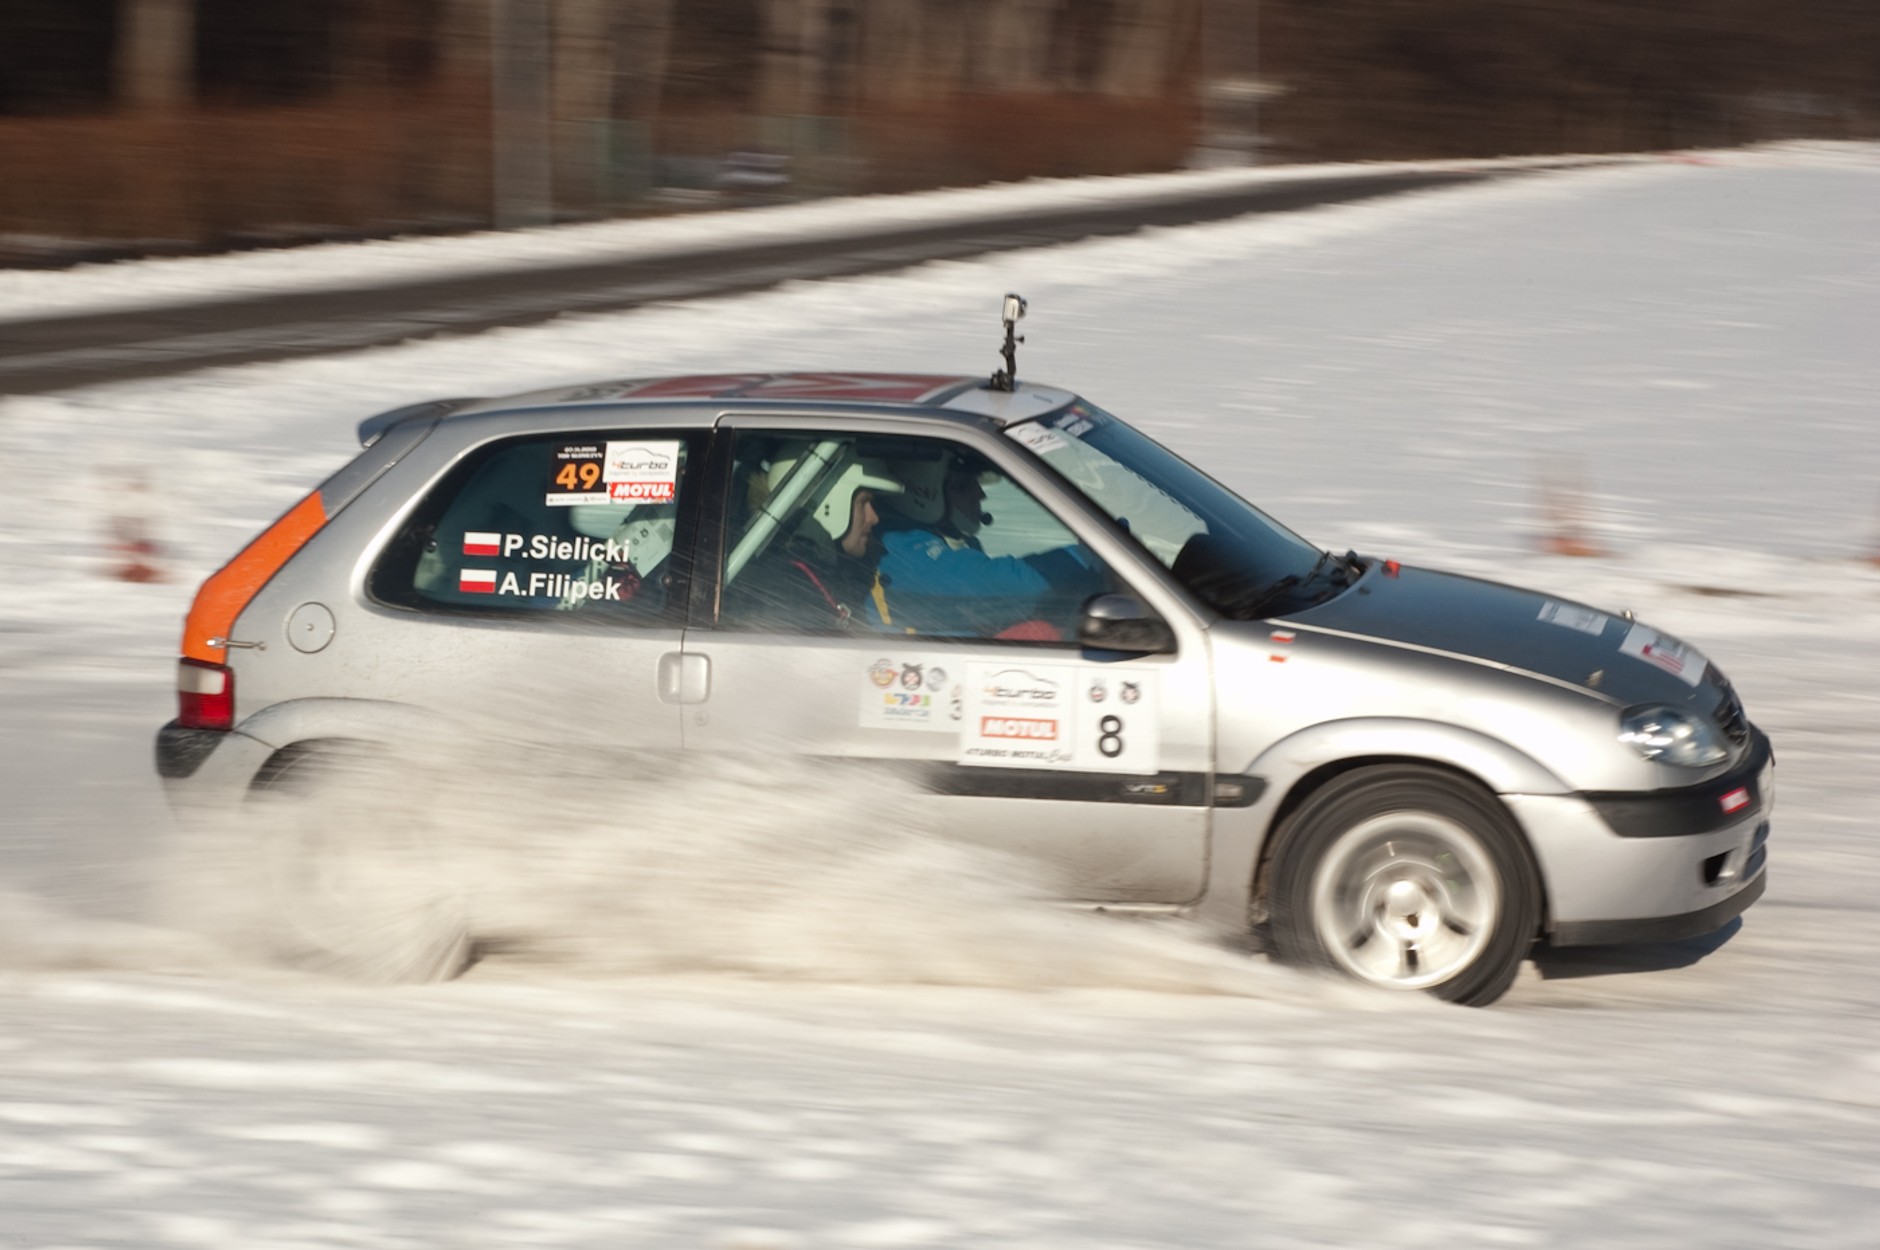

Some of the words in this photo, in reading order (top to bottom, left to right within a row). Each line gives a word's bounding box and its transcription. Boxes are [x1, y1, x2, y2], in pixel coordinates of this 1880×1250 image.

[556, 462, 600, 490] 49
[612, 482, 672, 497] MOTUL
[503, 533, 630, 563] P.Sielicki
[498, 571, 622, 604] A.Filipek
[983, 718, 1055, 738] MOTUL
[1099, 714, 1123, 758] 8
